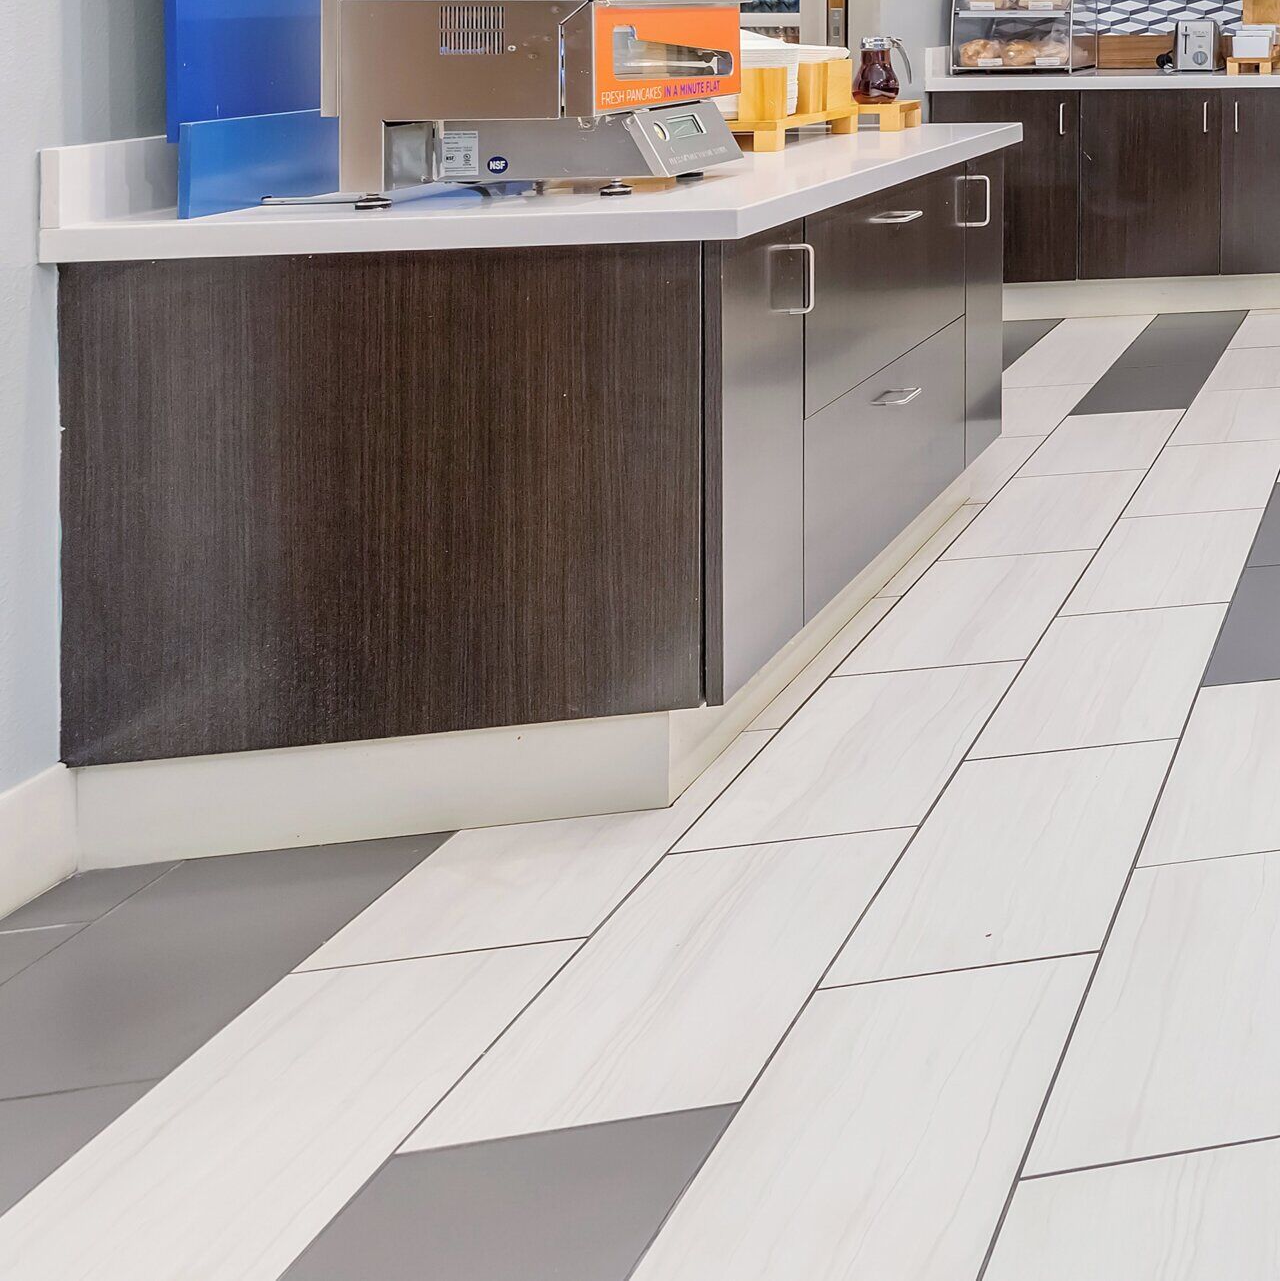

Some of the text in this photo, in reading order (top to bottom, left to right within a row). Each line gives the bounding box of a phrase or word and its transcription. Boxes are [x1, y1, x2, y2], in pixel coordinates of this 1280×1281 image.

[601, 80, 720, 105] FRESH PANCAKES IN A MINUTE FLAT
[489, 160, 506, 170] NSF
